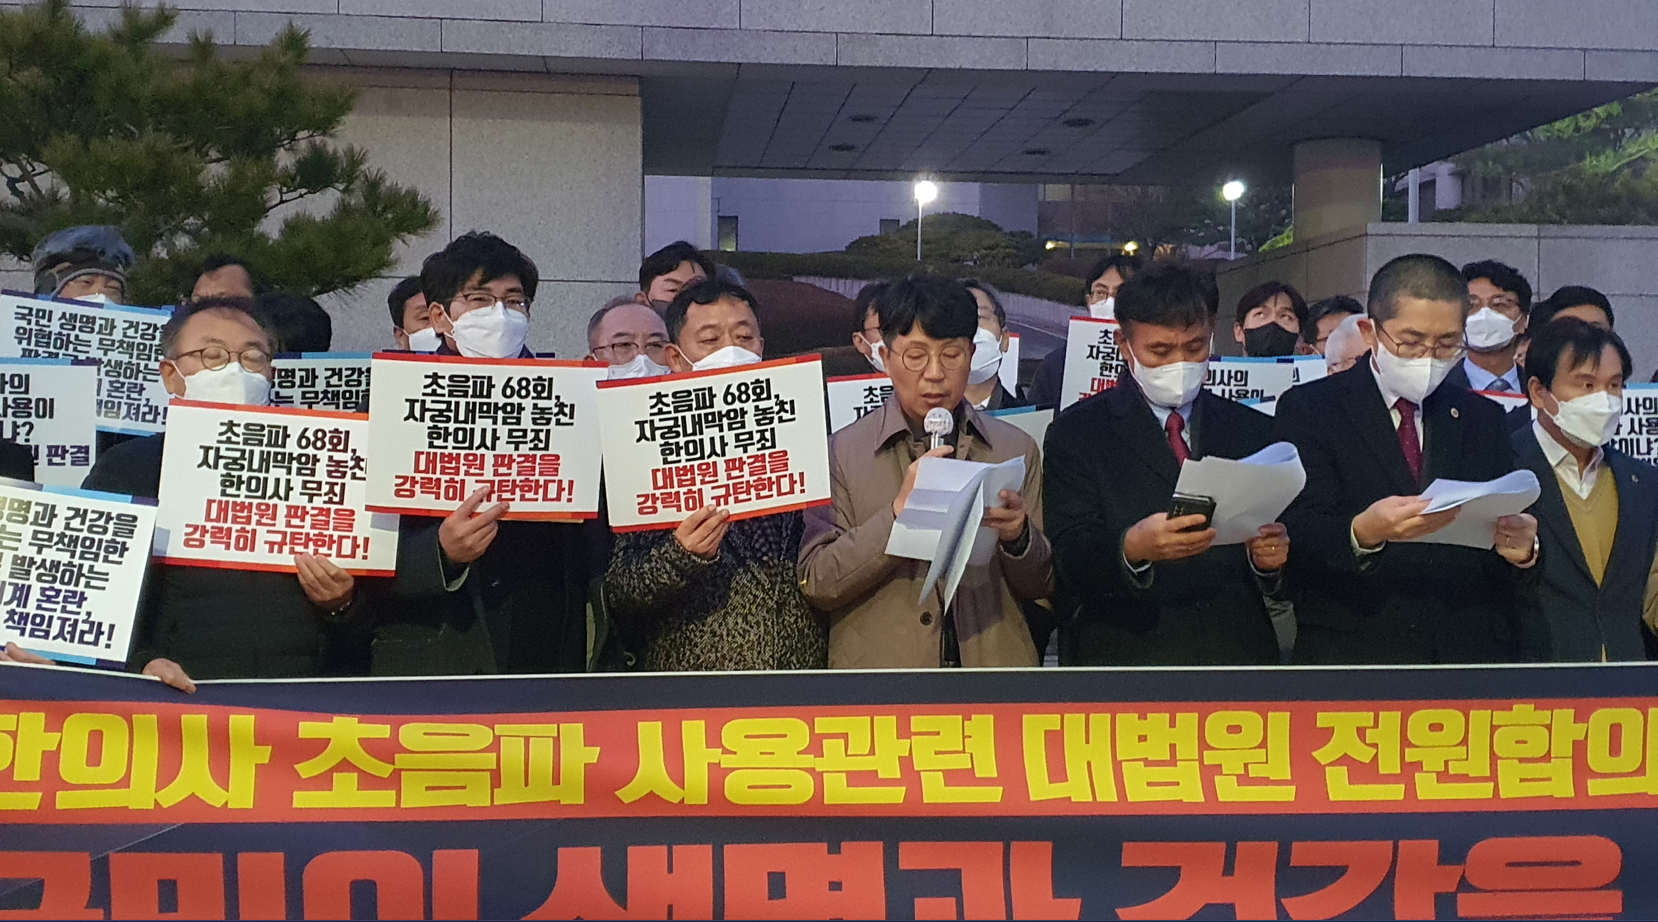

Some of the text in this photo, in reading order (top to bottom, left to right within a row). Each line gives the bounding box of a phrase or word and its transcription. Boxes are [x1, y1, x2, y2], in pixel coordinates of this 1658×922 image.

[13, 326, 91, 354] 위험하는
[14, 304, 163, 342] 국민 생명과 건강
[96, 357, 160, 383] 생하는
[269, 367, 319, 389] 명과
[107, 379, 152, 407] 혼란,
[421, 372, 561, 405] 초음파 68회,
[648, 378, 781, 417] 초음파 68회,
[96, 399, 168, 426] 임져라!
[403, 398, 575, 427] 자궁내막암 놓친
[634, 399, 796, 444] 자궁내막암 놓친
[1620, 397, 1658, 415] 사의
[216, 420, 357, 457] 초음파 68회,
[427, 424, 551, 451] 한의사 무죄
[659, 426, 777, 465] 한의사 무죄
[46, 444, 90, 467] 판결
[197, 445, 321, 478] 자궁내막암
[413, 450, 561, 477] 대법원 판결을
[651, 449, 790, 491] 대법원 판결을
[220, 472, 346, 506] 한의사 무죄
[394, 474, 465, 502] 강력히
[636, 471, 806, 516] 강력히 규탄한다!
[64, 506, 138, 540] 건강을
[204, 498, 355, 533] 대법원 판결을
[28, 529, 129, 565] 무책임한
[183, 523, 370, 561] 강력히 규탄한다!
[8, 554, 110, 590] 발생하는
[35, 586, 93, 621] 혼란,
[3, 608, 116, 649] 책임져라!
[292, 716, 600, 808] 초음파
[615, 713, 1004, 804] 사용관련
[1022, 710, 1297, 802] 대법원
[1312, 704, 1658, 801] 전원합의
